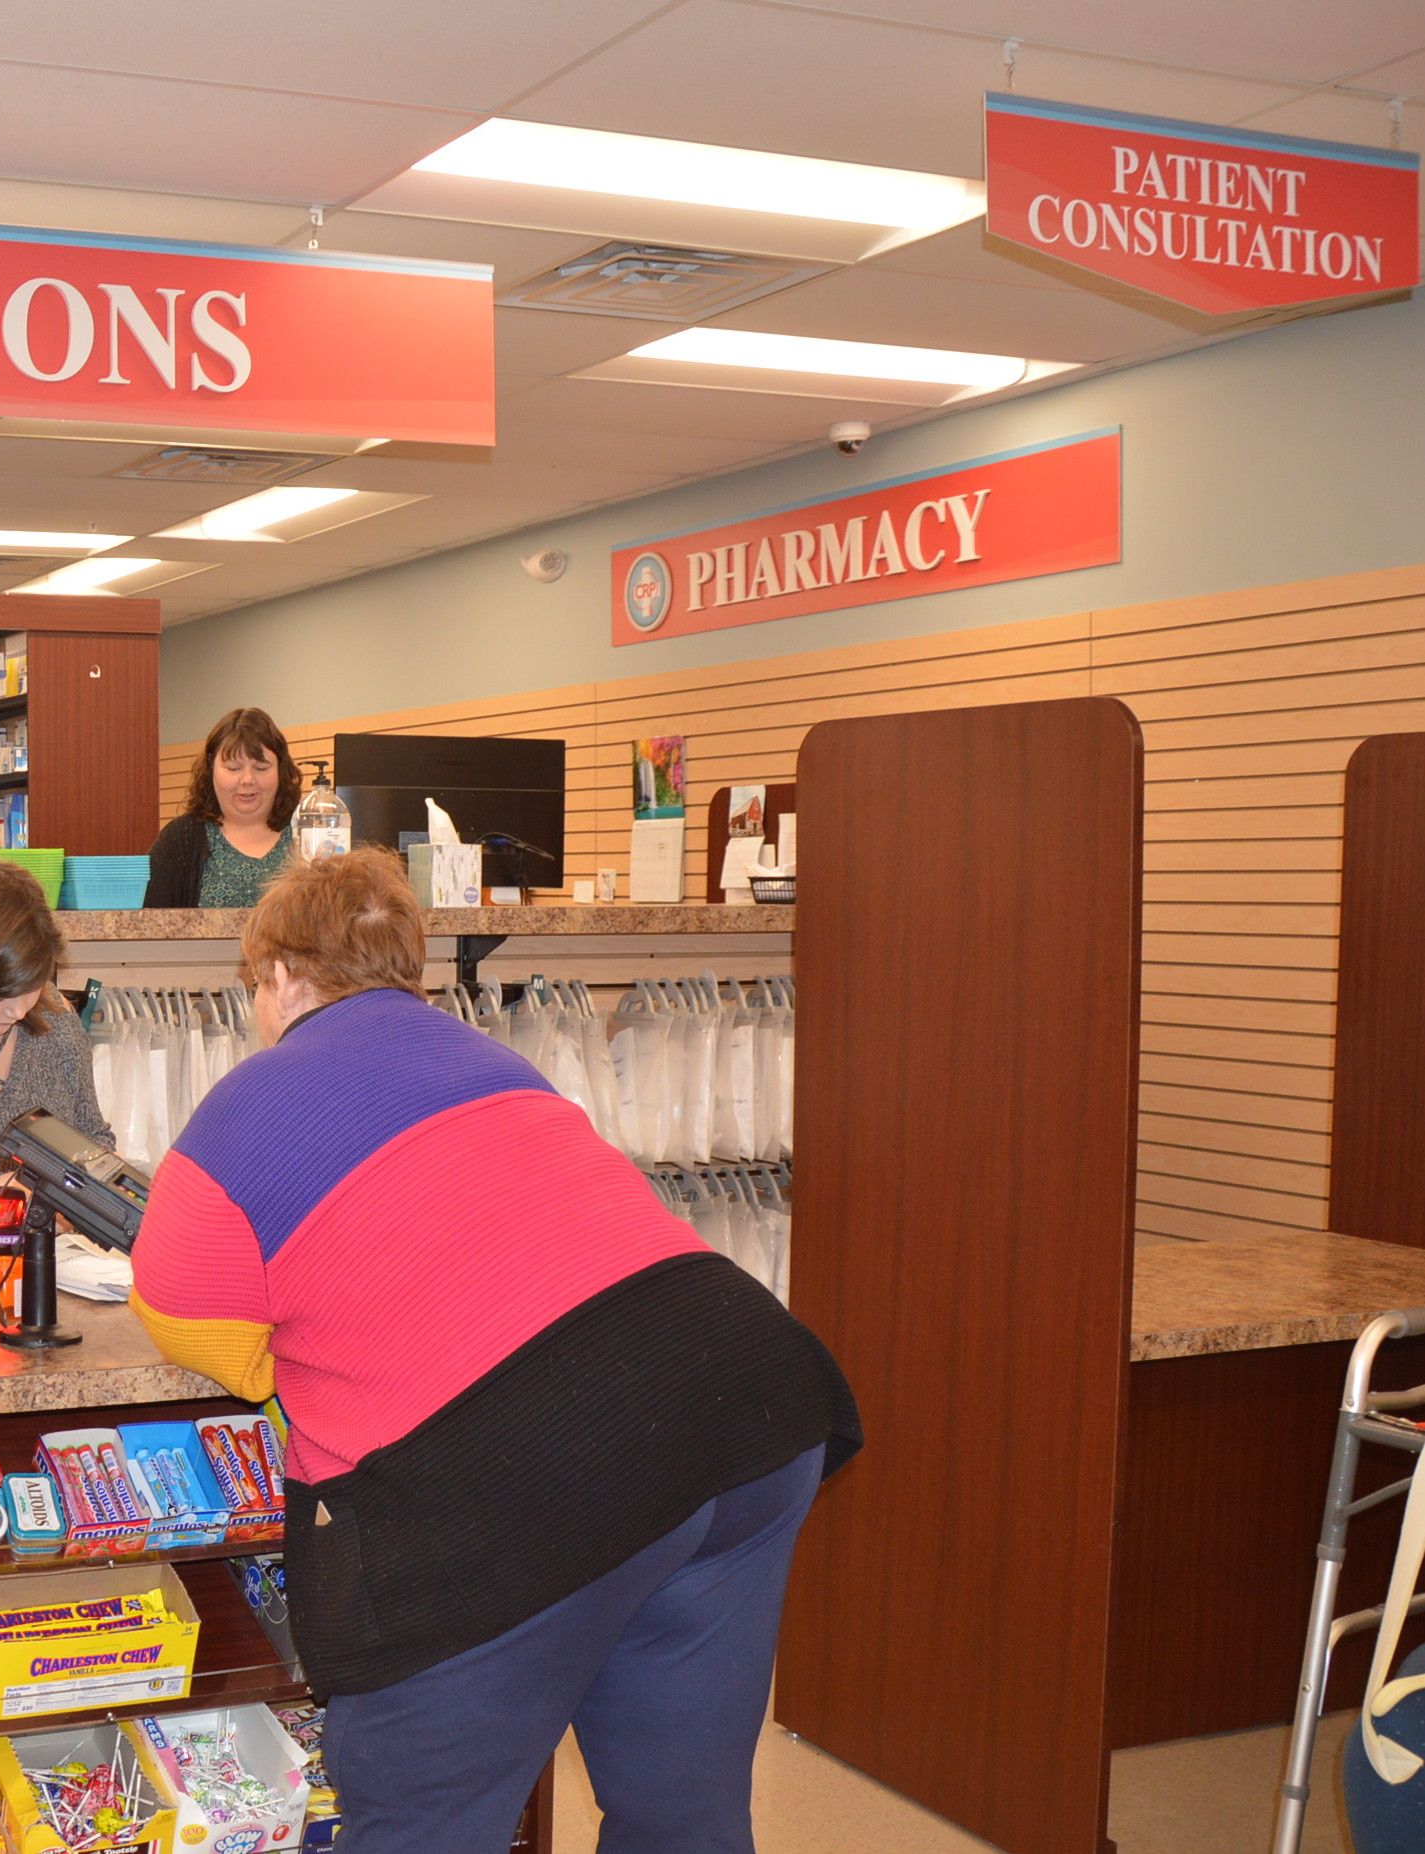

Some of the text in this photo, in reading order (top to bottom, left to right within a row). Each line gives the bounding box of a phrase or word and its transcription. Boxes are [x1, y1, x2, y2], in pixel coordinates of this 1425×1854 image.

[1111, 146, 1306, 216] PATIENT
[1028, 194, 1383, 283] CONSULTATION
[687, 489, 991, 612] PHARMACY
[88, 986, 99, 999] K
[533, 978, 544, 989] M
[218, 1429, 245, 1481] mentos
[260, 1423, 275, 1466] mentos
[215, 1456, 241, 1507] mentos
[26, 1481, 50, 1527] ALTOIDS
[73, 1526, 147, 1540] mentos
[153, 1522, 205, 1532] mentos
[75, 1598, 123, 1619] CHEW
[30, 1644, 164, 1677] CHARLESTON CHEW
[69, 1668, 94, 1677] VANILLA
[215, 1830, 263, 1848] BLOW
